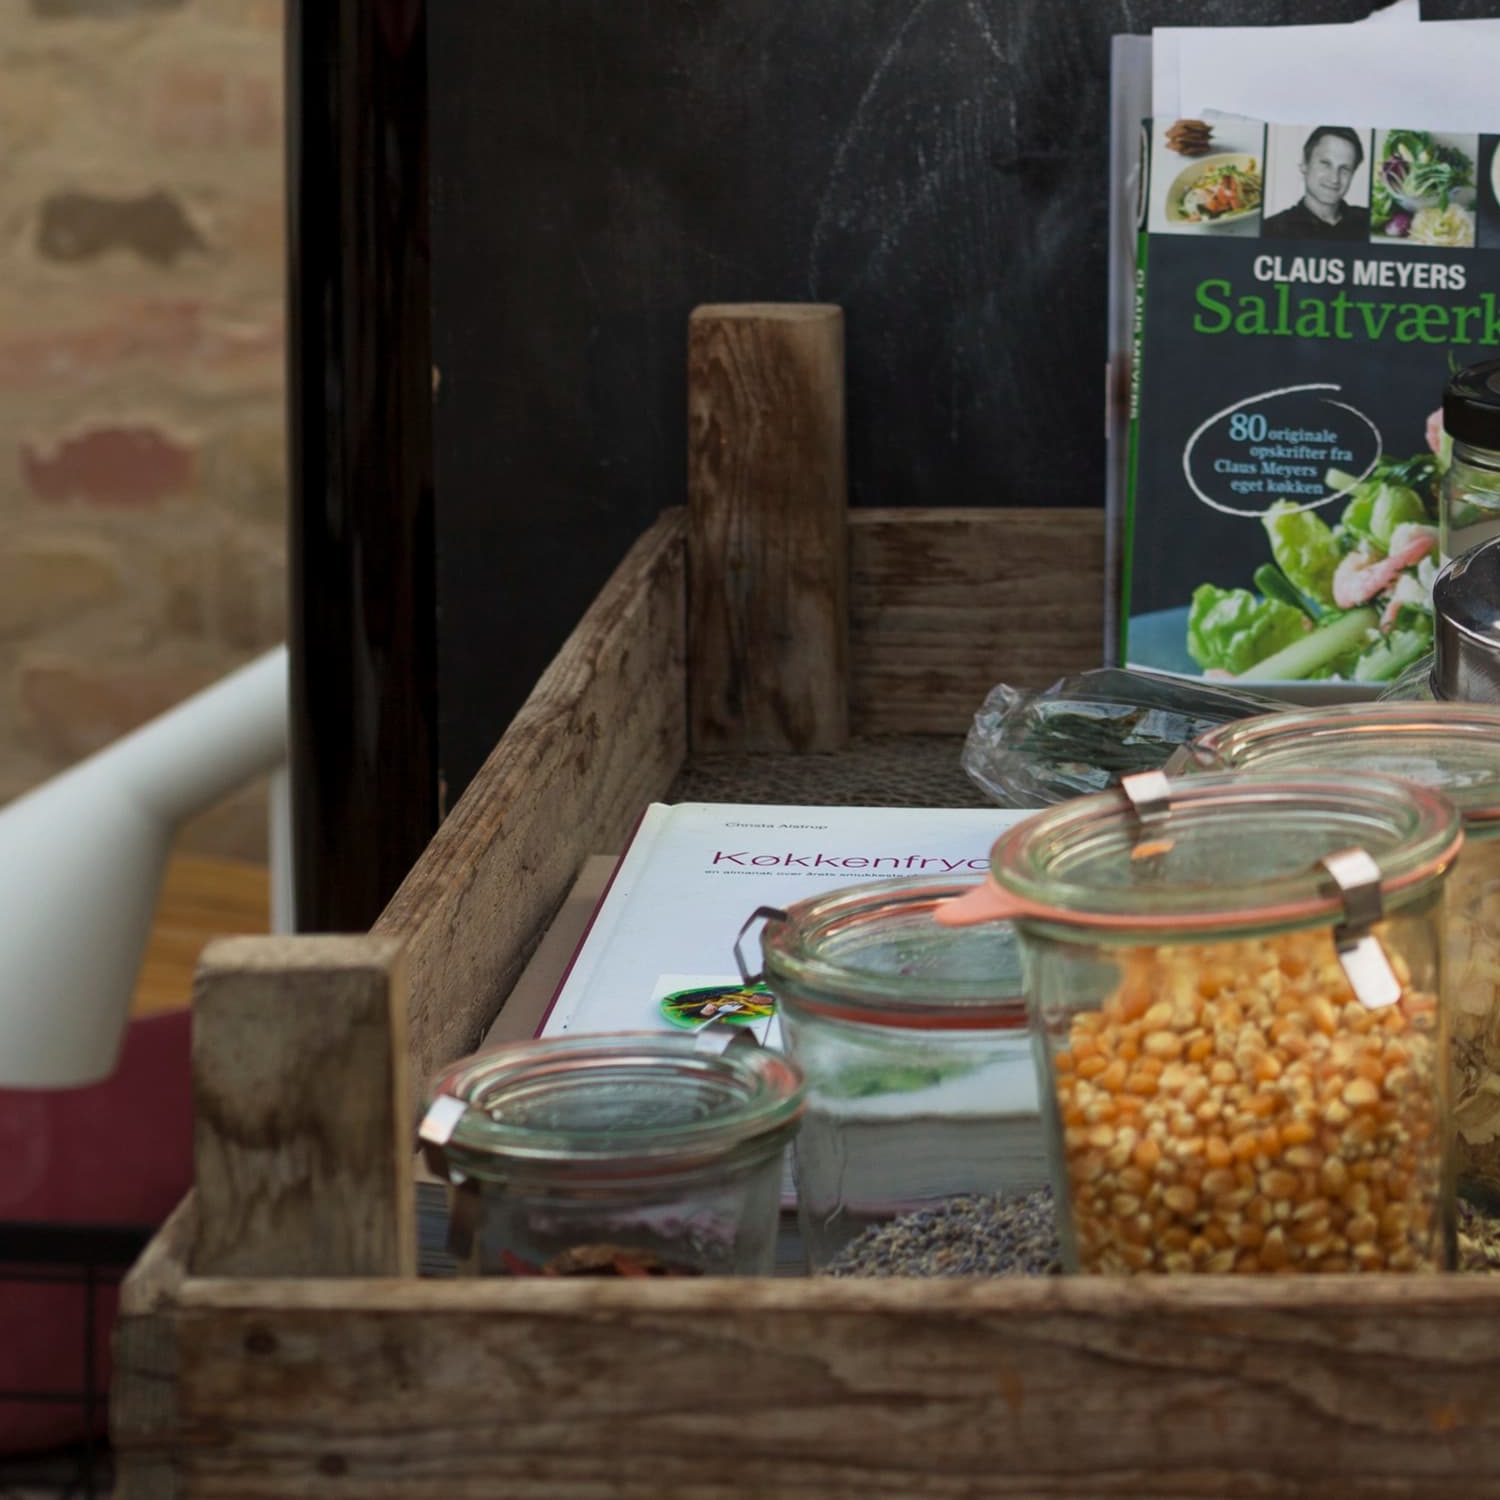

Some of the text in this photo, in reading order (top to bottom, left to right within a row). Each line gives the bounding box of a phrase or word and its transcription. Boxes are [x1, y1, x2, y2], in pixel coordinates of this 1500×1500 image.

[1254, 255, 1466, 290] CLAUS MEYERS
[1228, 413, 1338, 444] 80 originale
[1250, 444, 1353, 461] opskrifter fra
[1214, 459, 1318, 477] Claus Meyers
[1230, 479, 1324, 494] eget køkken
[725, 821, 829, 831] Christa Alstrup
